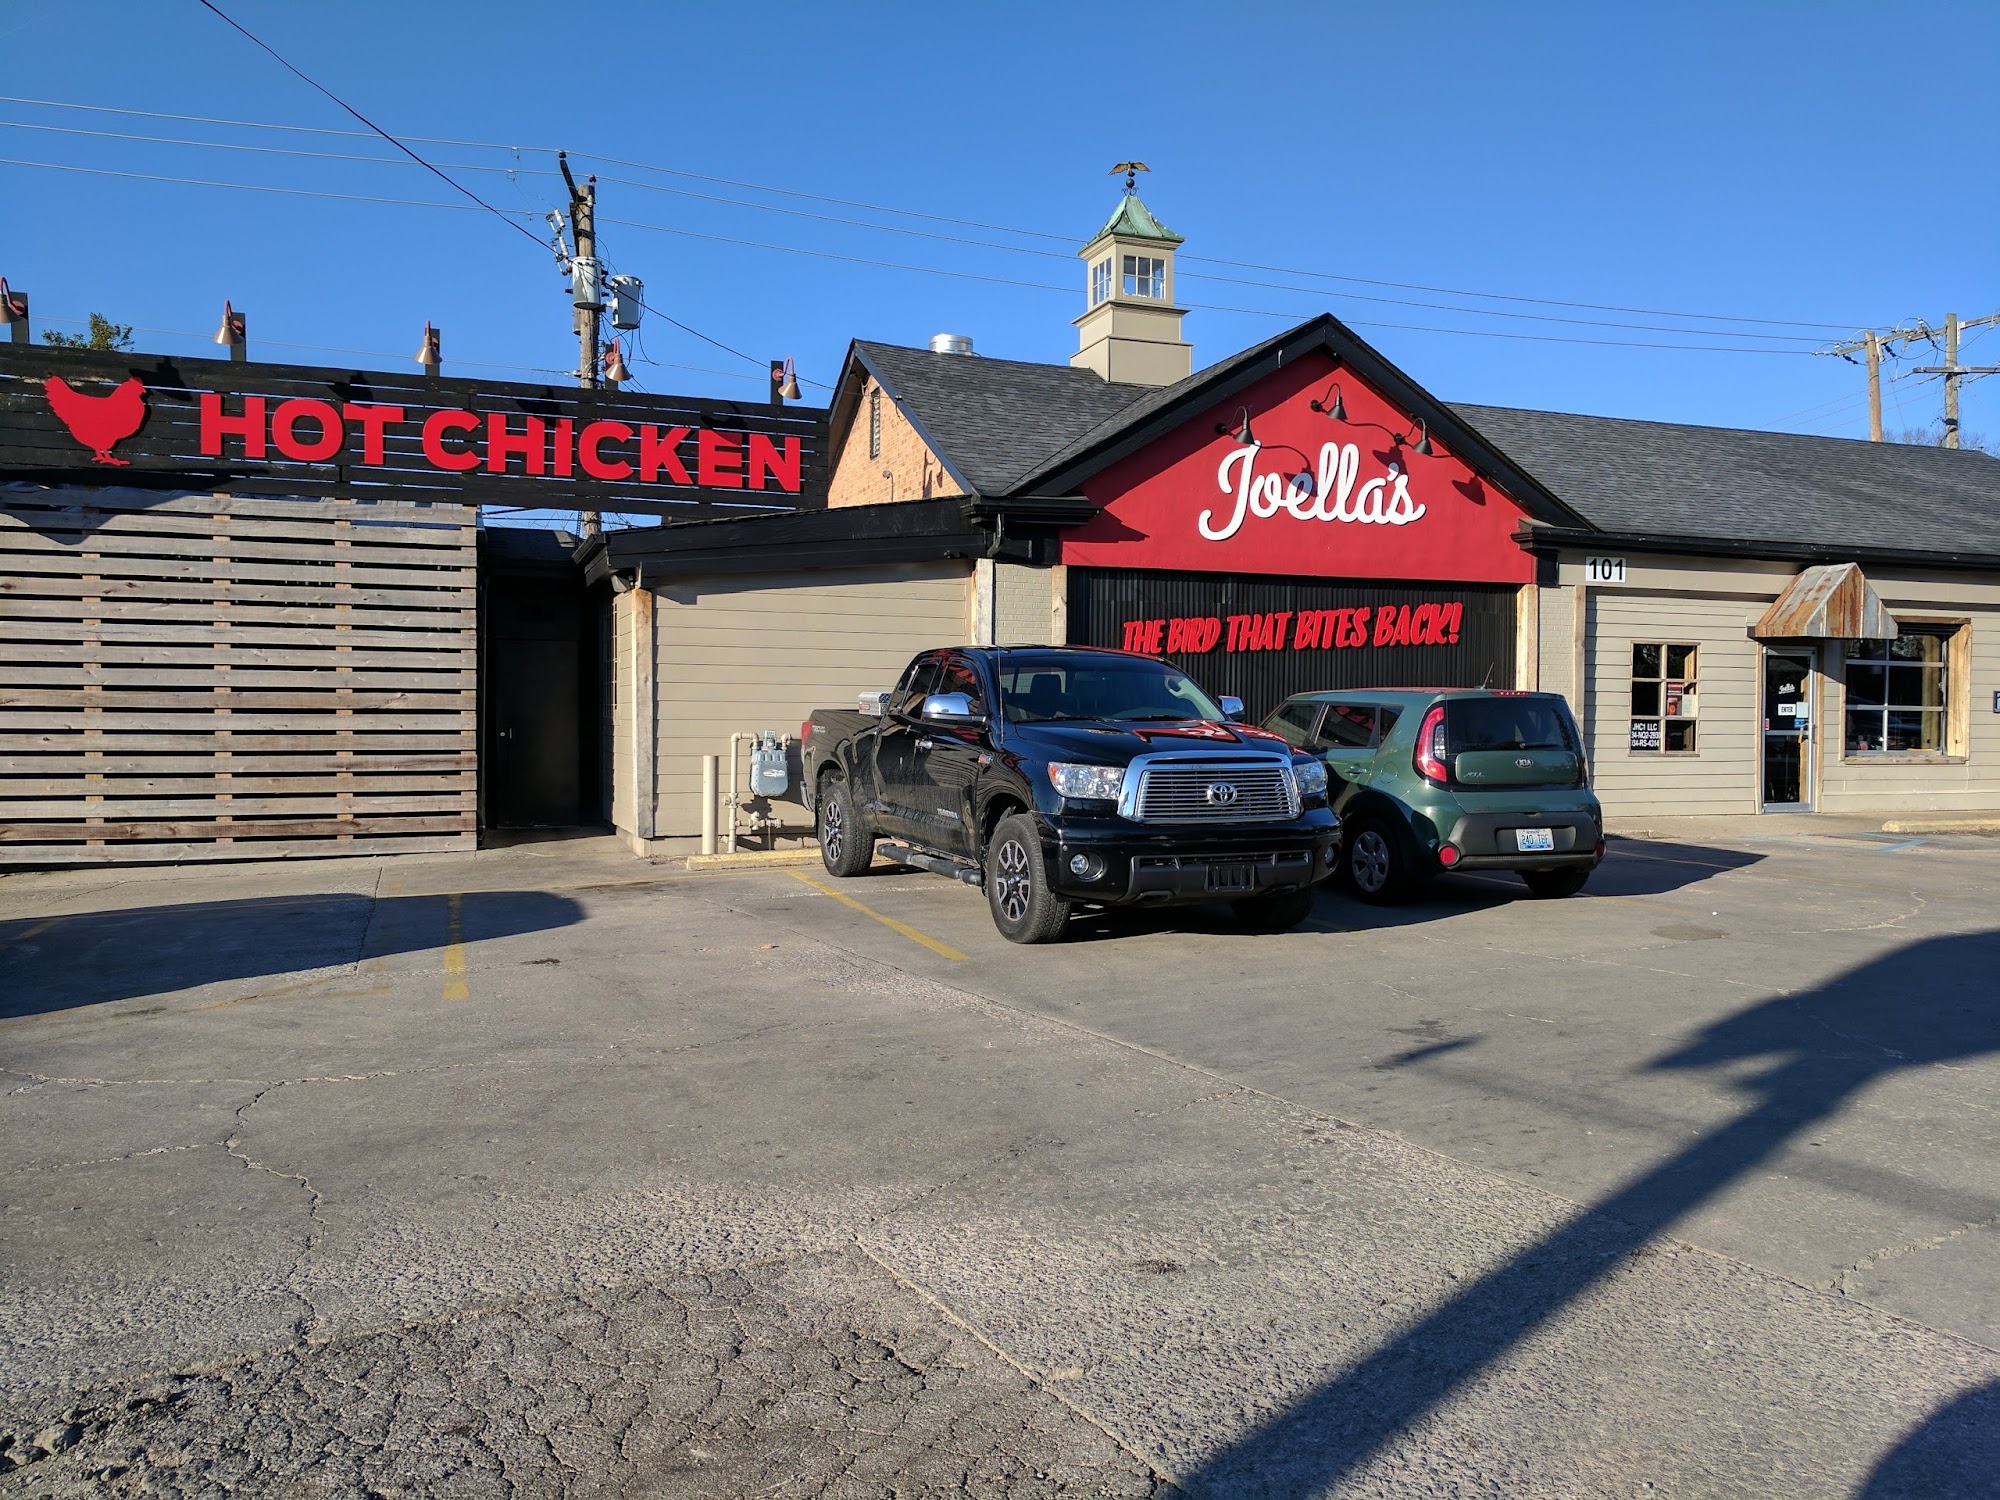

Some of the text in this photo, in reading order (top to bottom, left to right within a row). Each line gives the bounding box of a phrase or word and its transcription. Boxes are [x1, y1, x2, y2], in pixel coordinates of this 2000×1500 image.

[200, 393, 801, 492] HOT CHICKEN
[1198, 440, 1427, 541] Joella's
[1588, 557, 1623, 581] 101
[1123, 602, 1464, 654] THE BIRD THAT BITES BACK!
[1646, 722, 1658, 731] LLC
